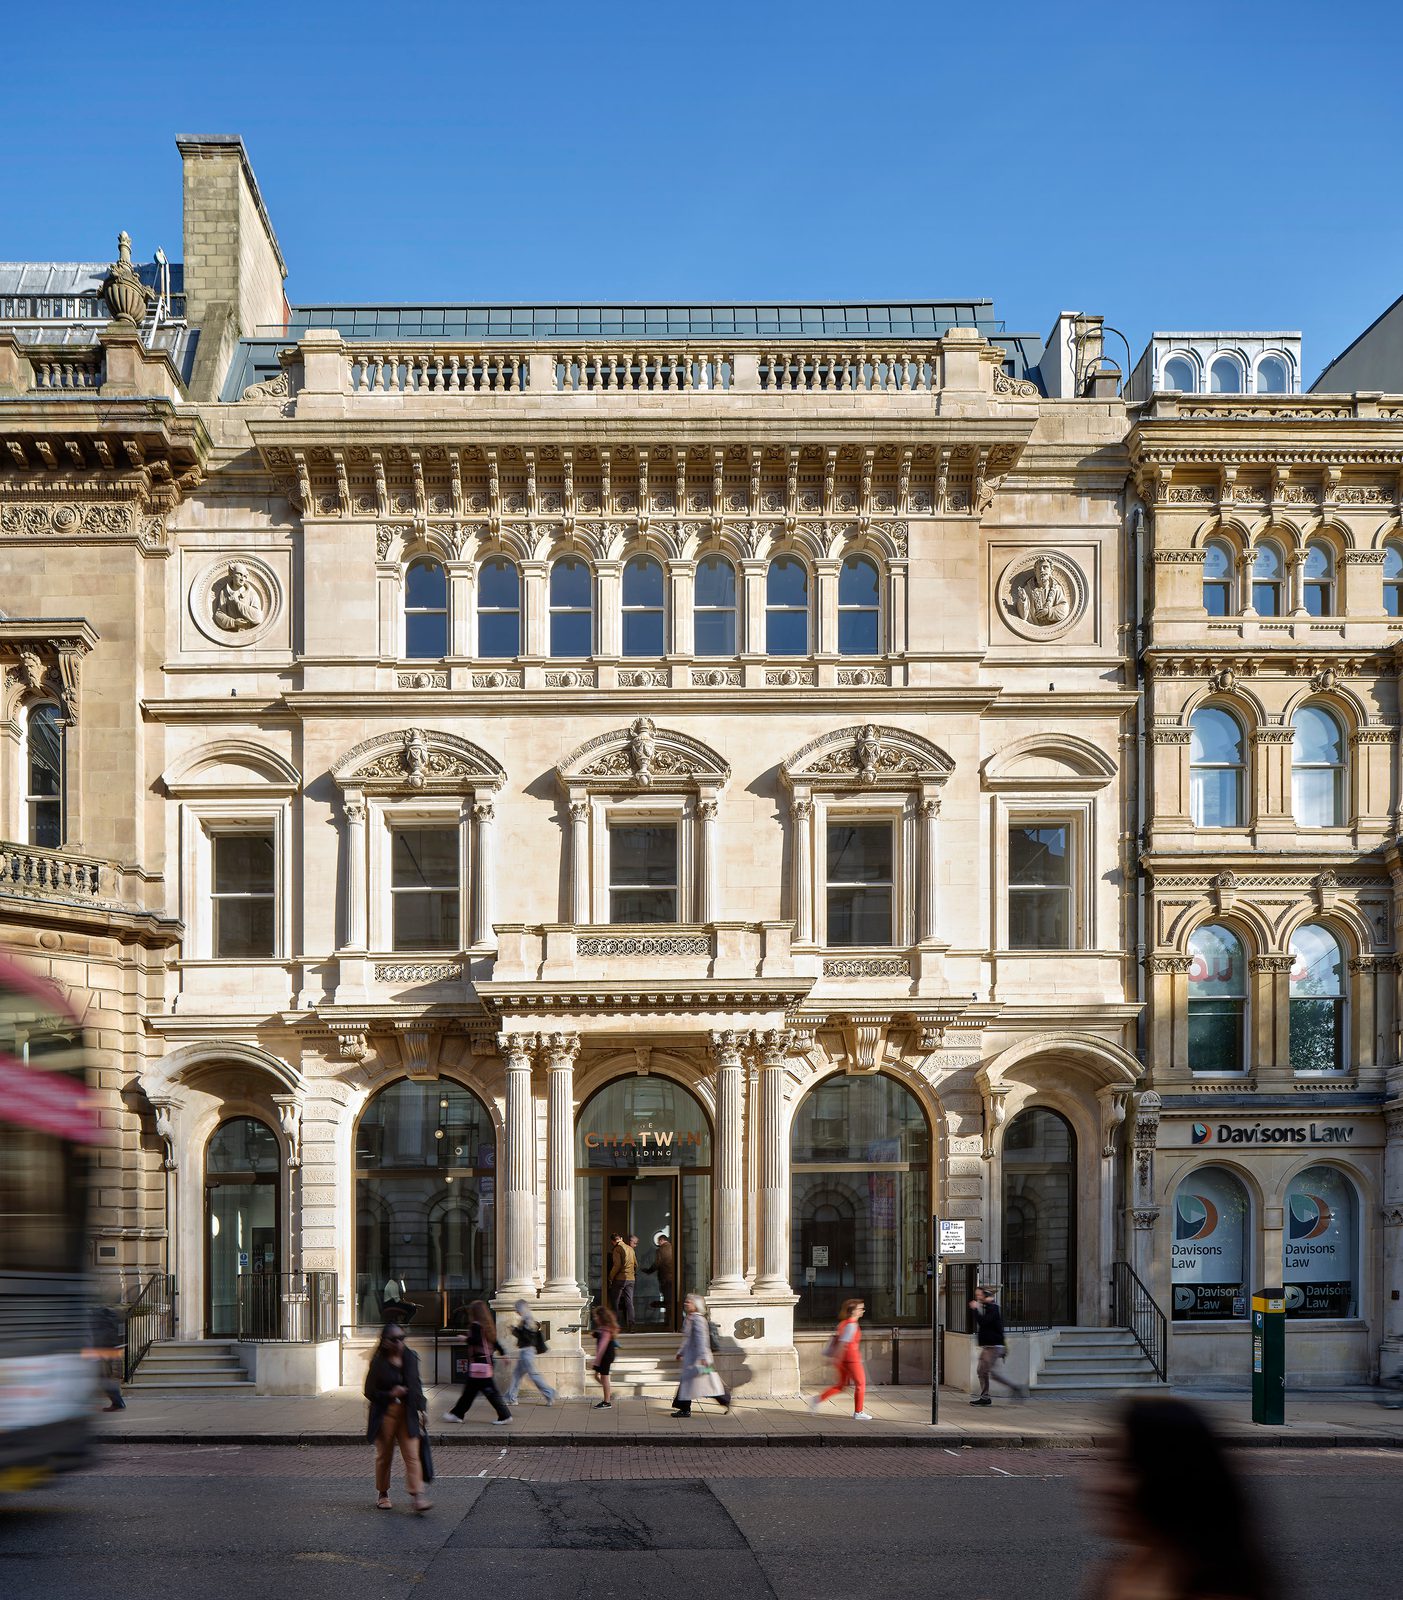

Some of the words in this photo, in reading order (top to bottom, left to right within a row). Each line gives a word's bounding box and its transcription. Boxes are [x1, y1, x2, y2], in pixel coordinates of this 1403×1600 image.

[1217, 1122, 1306, 1143] Davisons
[1310, 1123, 1353, 1142] Law
[584, 1131, 702, 1148] CHATWIN
[1172, 1244, 1222, 1255] Davisons
[1285, 1243, 1335, 1254] Davisons
[1172, 1257, 1196, 1268] Law
[1285, 1257, 1309, 1267] Law
[1197, 1286, 1244, 1297] Davisons
[1306, 1285, 1352, 1296] Davisons
[1197, 1299, 1220, 1310] Law
[1306, 1298, 1329, 1308] Law
